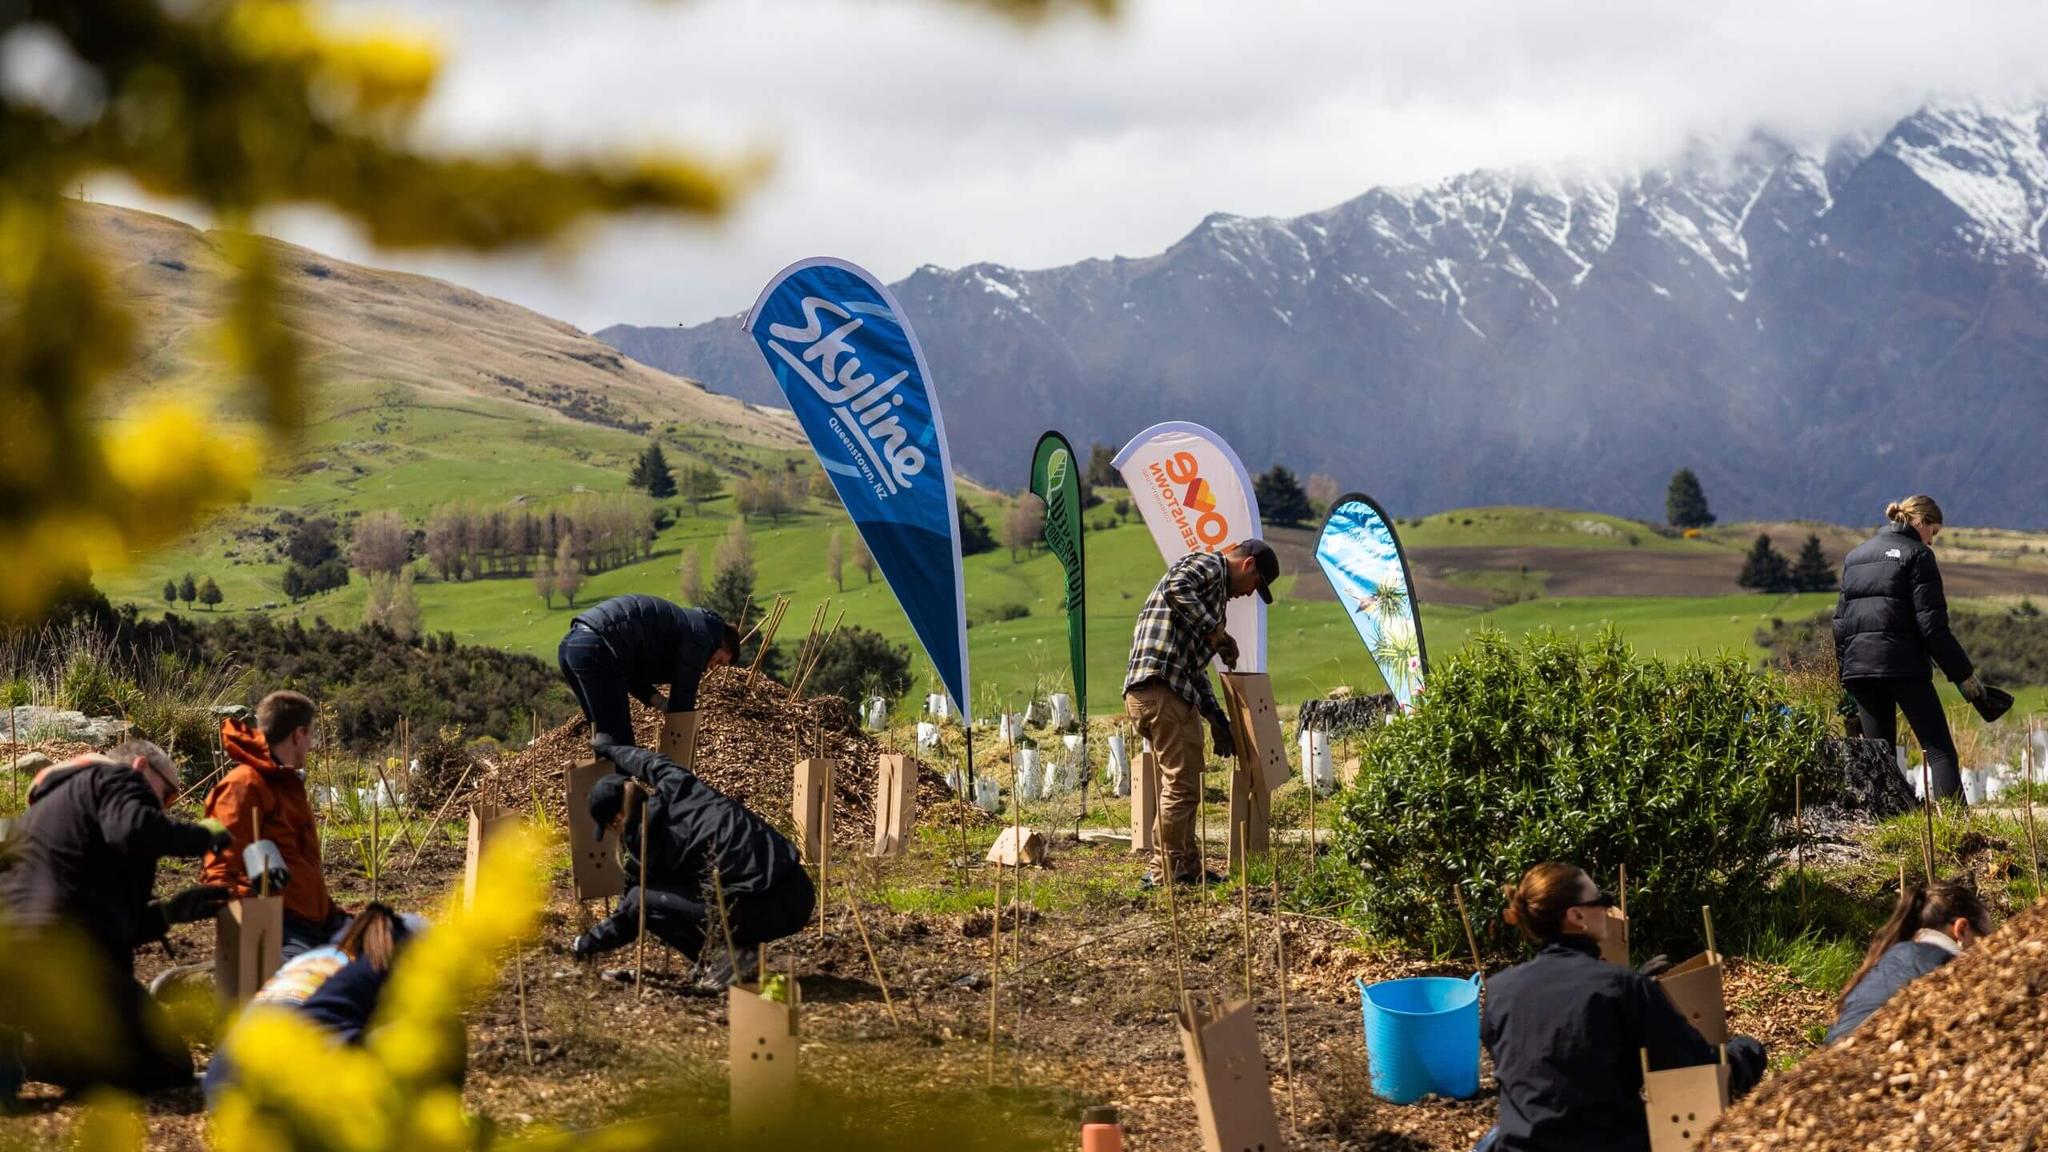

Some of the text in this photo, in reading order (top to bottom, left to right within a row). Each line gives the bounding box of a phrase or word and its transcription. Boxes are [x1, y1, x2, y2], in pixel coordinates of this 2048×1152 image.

[768, 297, 925, 490] Skyline
[829, 417, 889, 500] Queenstown, NZ
